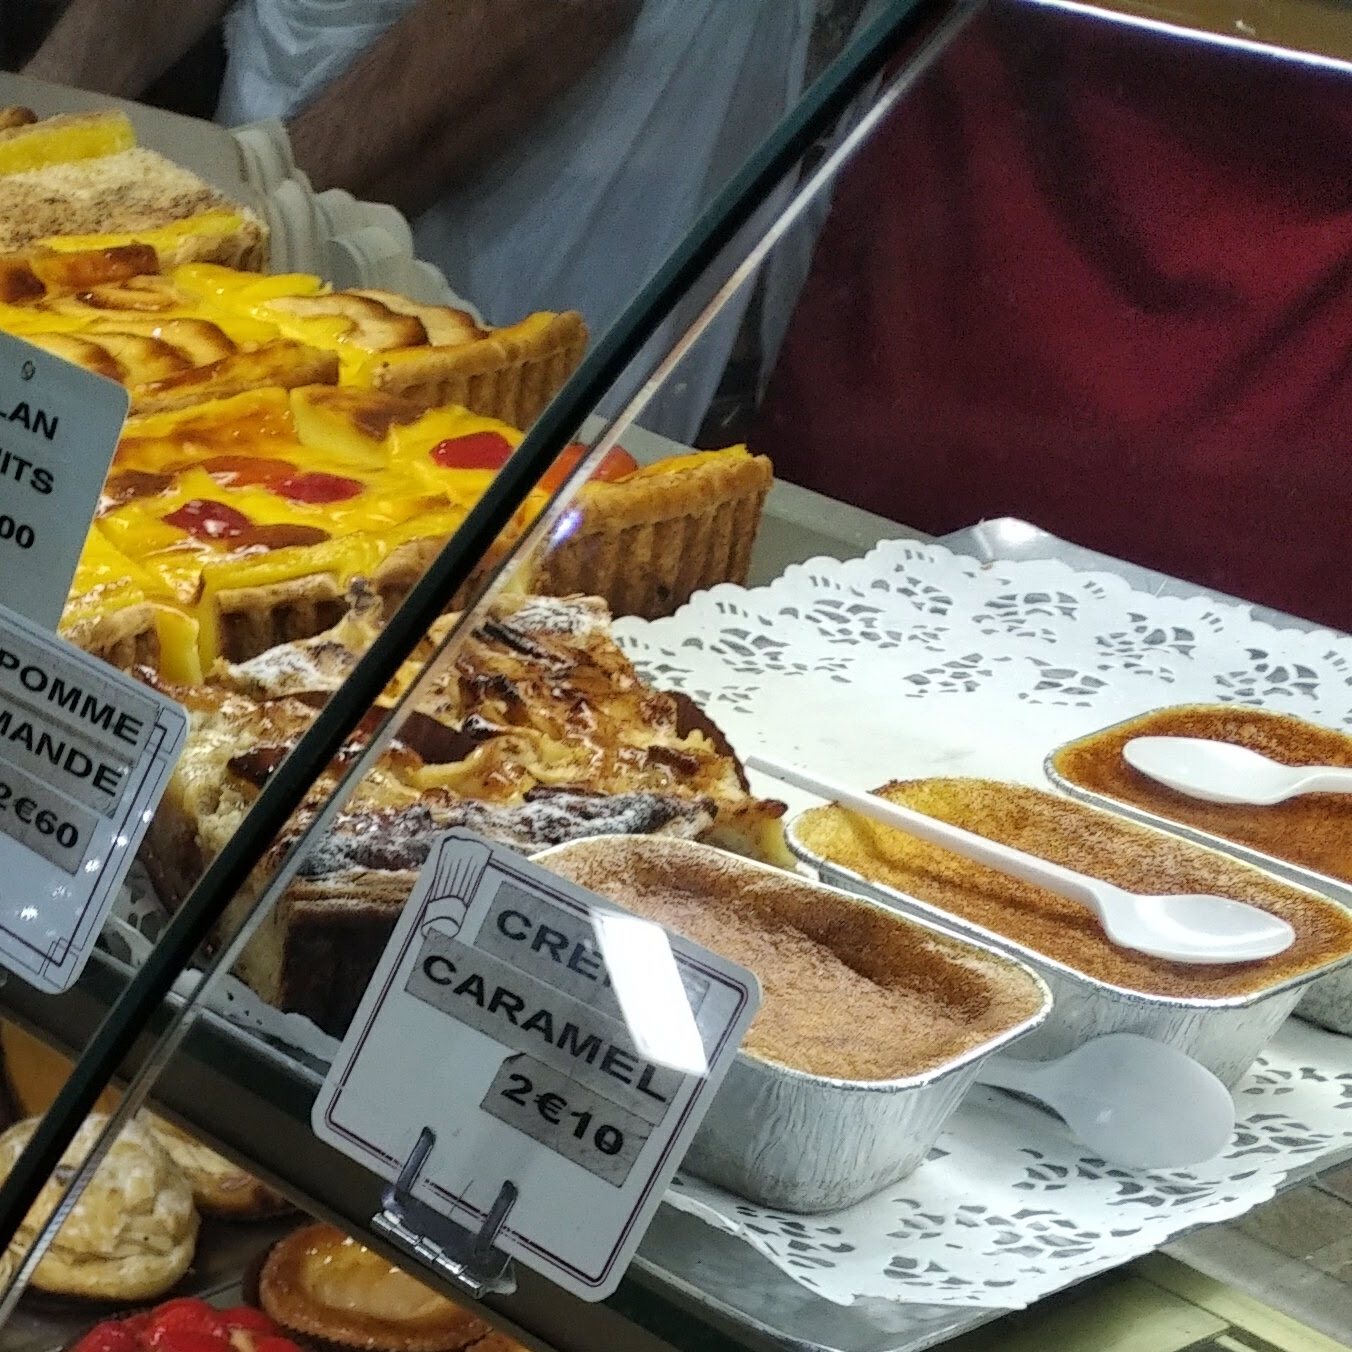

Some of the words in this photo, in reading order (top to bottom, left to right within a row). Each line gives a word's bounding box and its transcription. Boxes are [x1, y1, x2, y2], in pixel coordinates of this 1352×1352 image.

[496, 909, 612, 989] CRE
[422, 954, 667, 1102] CARAMEL
[501, 1072, 624, 1156] 2€10
